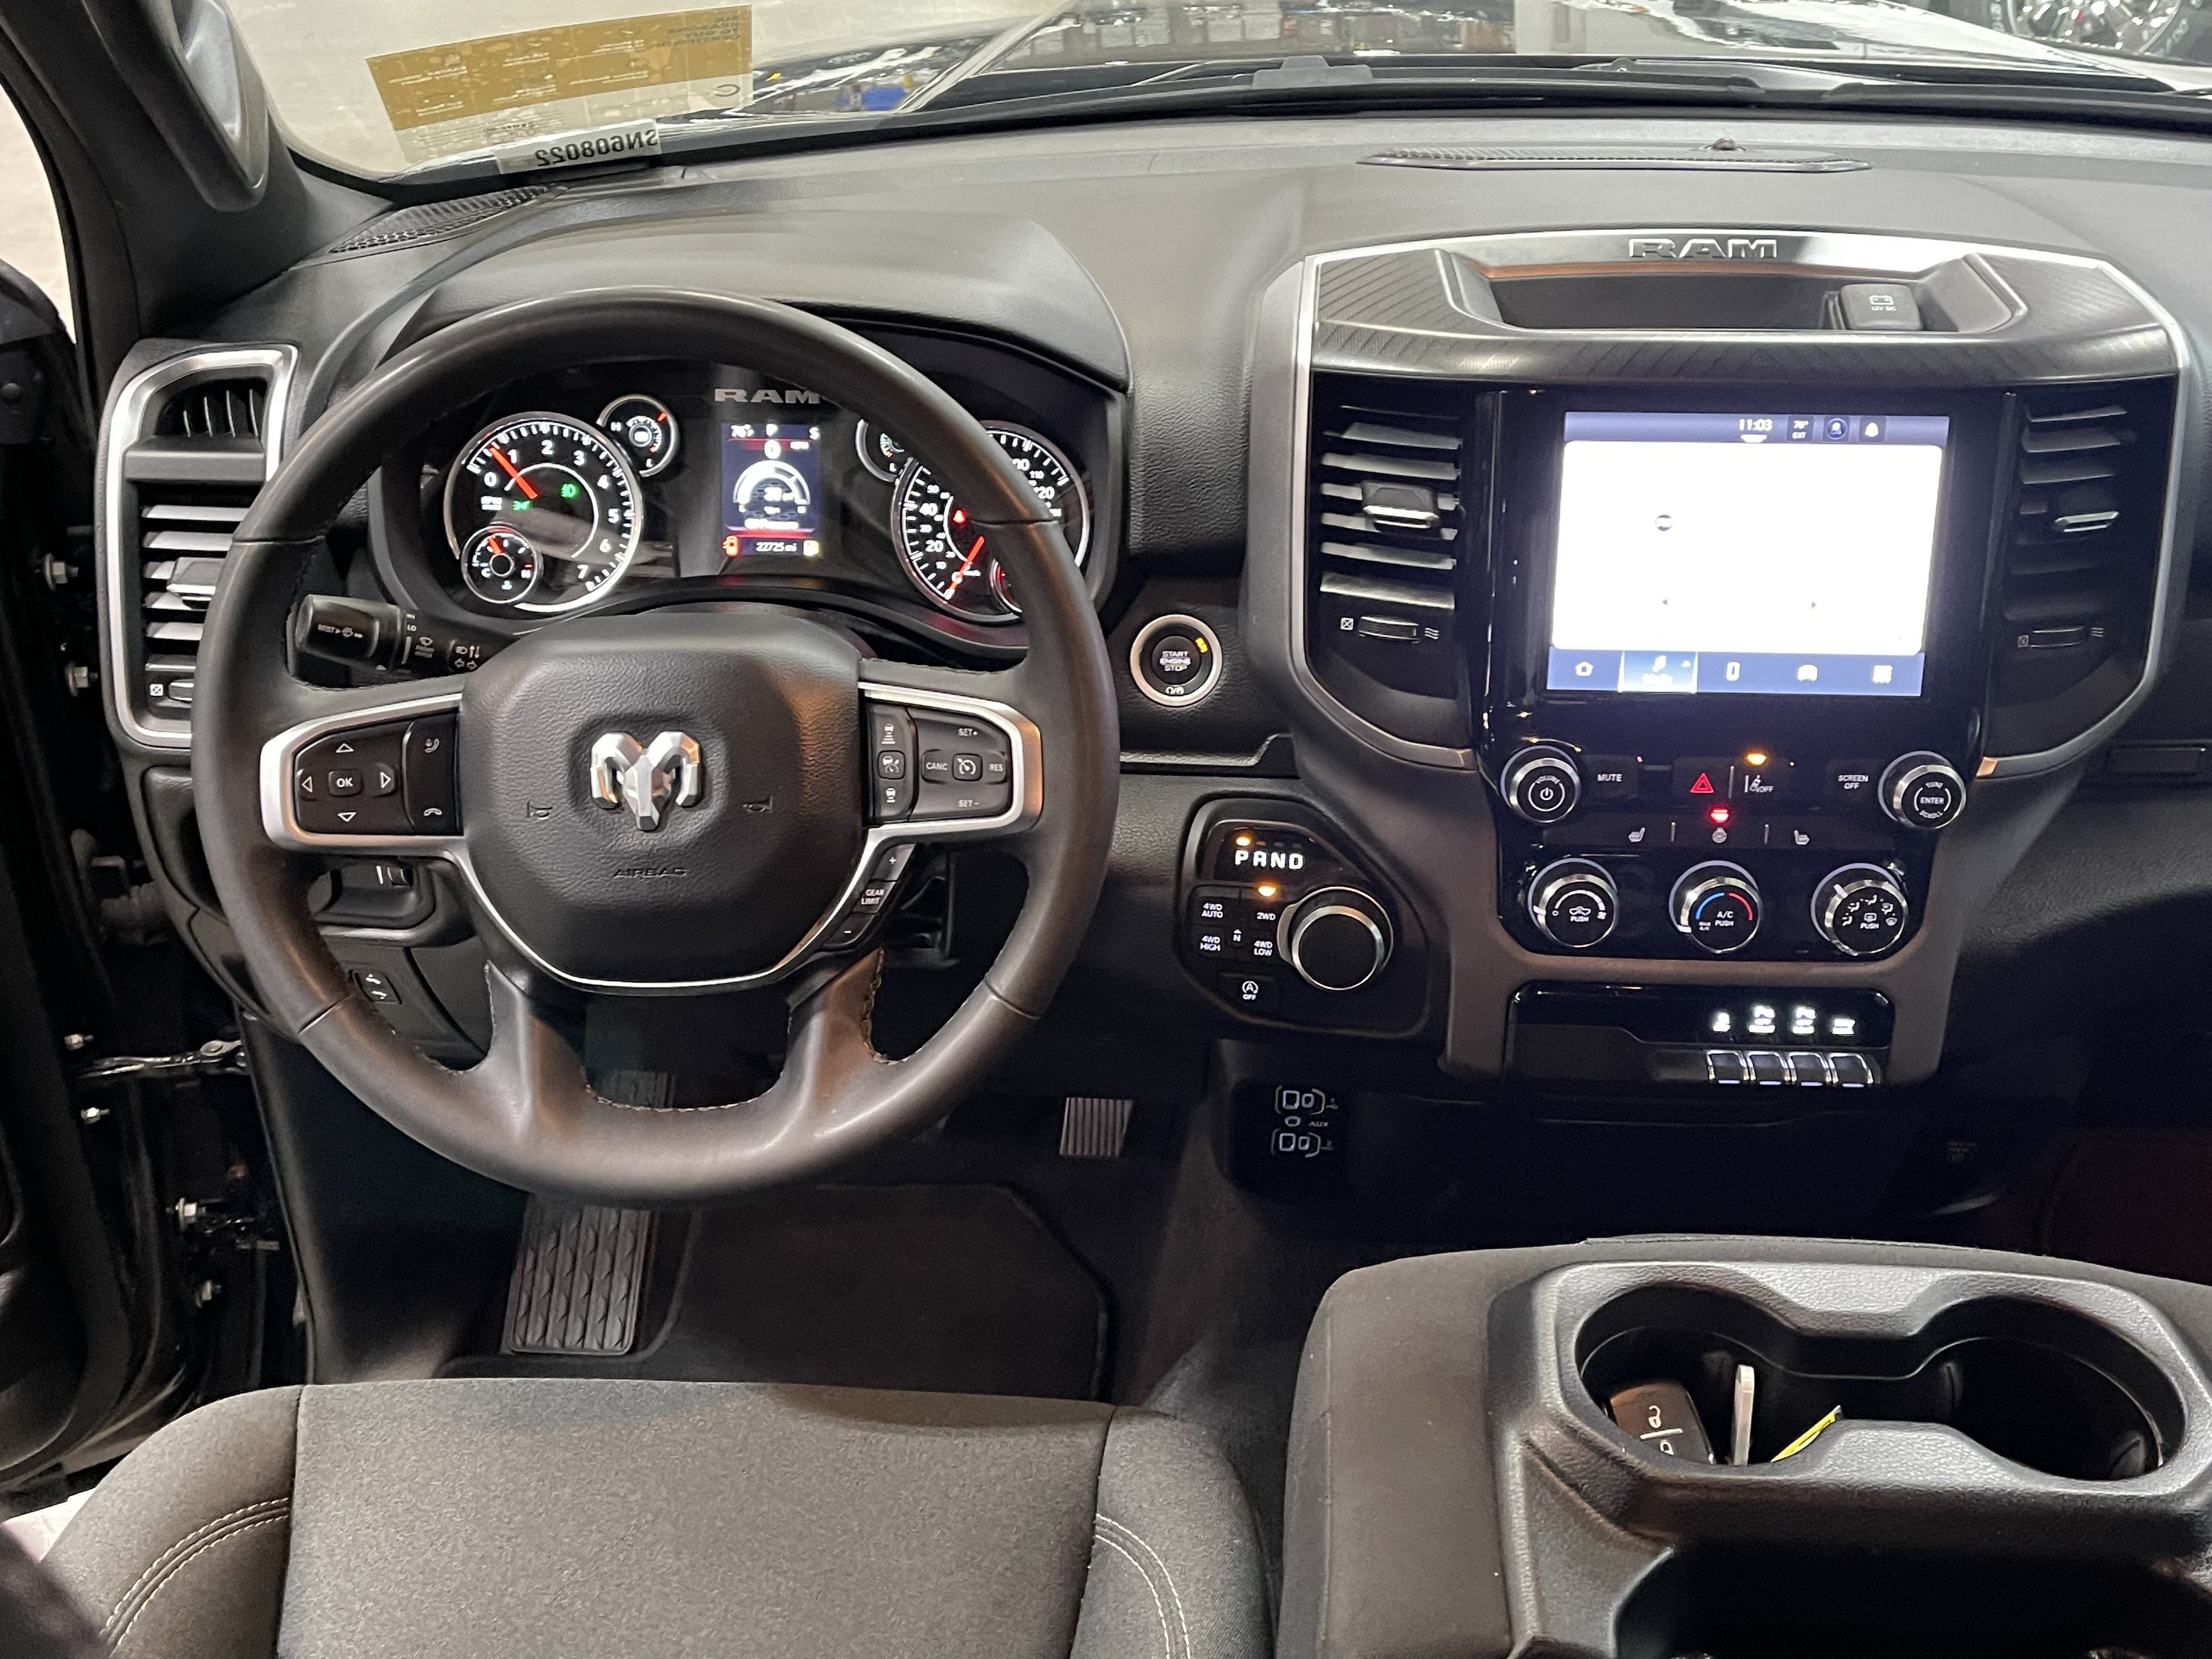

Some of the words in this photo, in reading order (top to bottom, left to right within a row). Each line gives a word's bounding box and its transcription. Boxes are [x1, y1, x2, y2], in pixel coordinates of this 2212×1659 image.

[1628, 238, 1778, 259] RAM
[715, 388, 820, 404] RAM
[1739, 418, 1773, 432] 11:03
[541, 439, 554, 456] 2
[507, 449, 518, 464] 1
[573, 450, 585, 466] 3
[484, 472, 498, 487] 0
[597, 475, 610, 489] 4
[607, 508, 620, 523] 5
[599, 538, 611, 552] 6
[925, 539, 944, 553] 20
[481, 568, 491, 578] C
[577, 564, 589, 579] 7
[926, 762, 948, 771] CANC
[990, 763, 1004, 772] RES
[336, 777, 353, 788] OK
[1598, 774, 1622, 782] MUTE
[613, 867, 687, 878] AIRBAG
[1203, 902, 1223, 911] 4WD
[1201, 910, 1223, 918] AUTO
[1256, 912, 1276, 921] 2WD
[1201, 935, 1221, 944] 4WD
[1254, 940, 1273, 949] 4WD
[1200, 943, 1221, 951] HIGH
[1254, 948, 1273, 956] LOW
